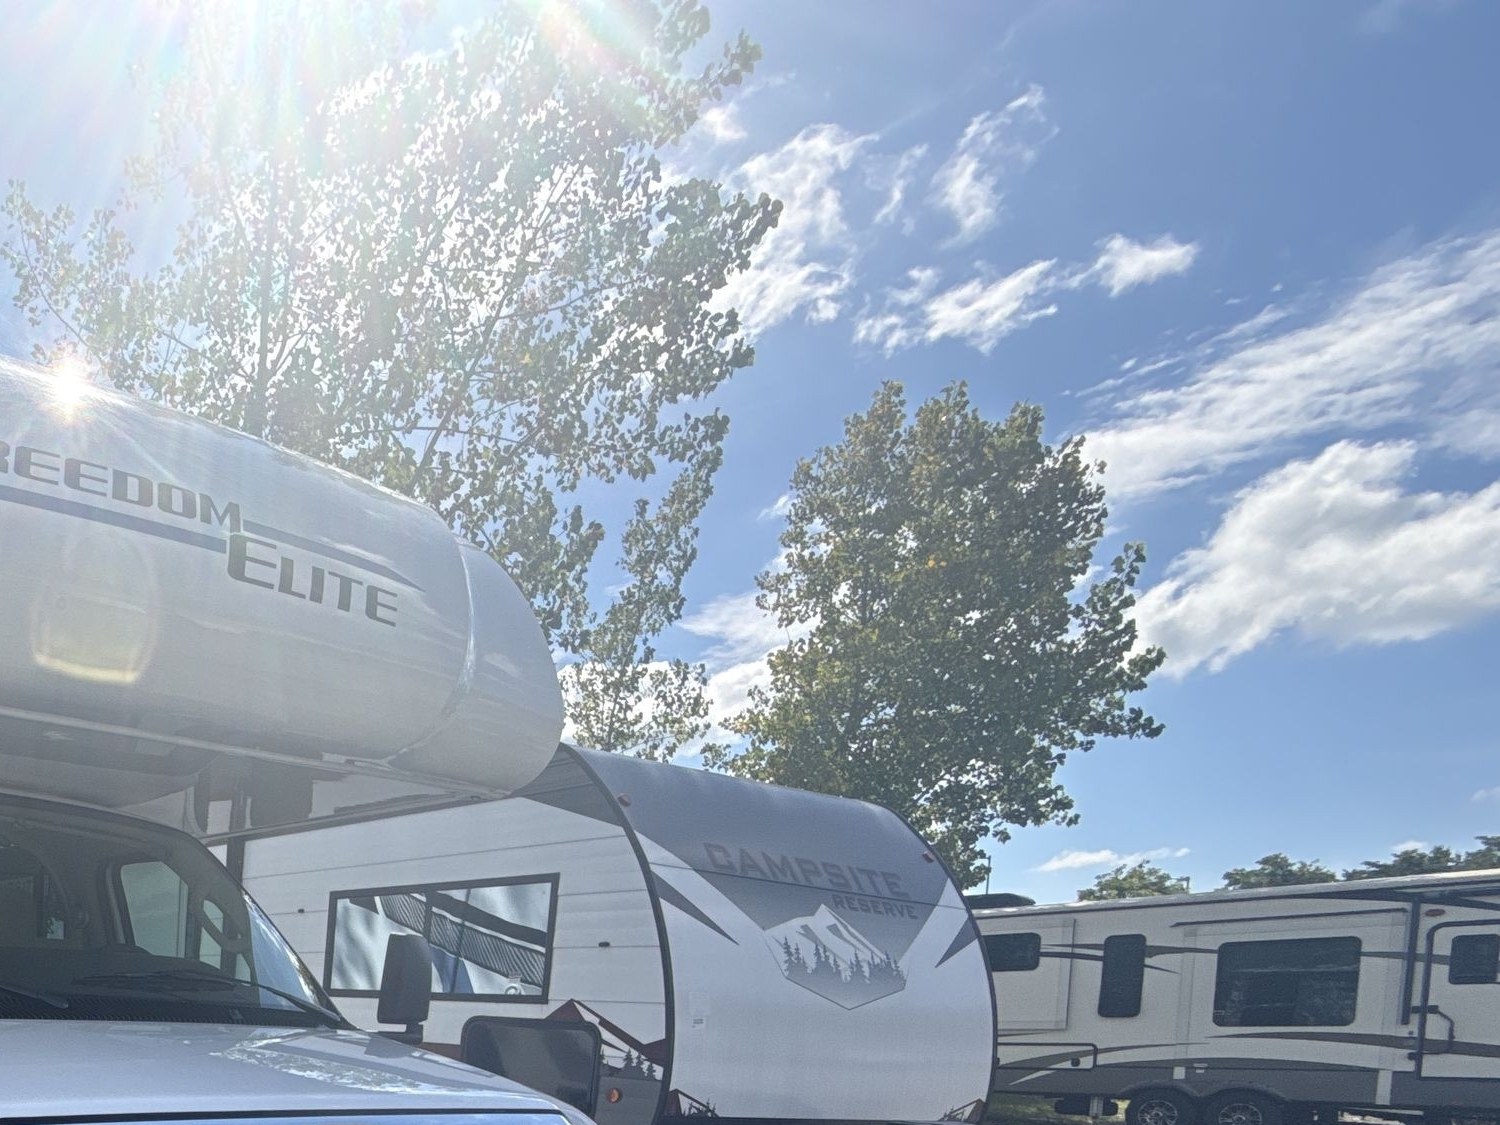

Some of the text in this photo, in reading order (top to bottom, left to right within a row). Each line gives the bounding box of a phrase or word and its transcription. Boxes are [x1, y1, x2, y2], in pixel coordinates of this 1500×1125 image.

[226, 533, 398, 627] ELITE
[703, 842, 911, 898] CAMPSITE
[832, 894, 918, 919] RESERVE
